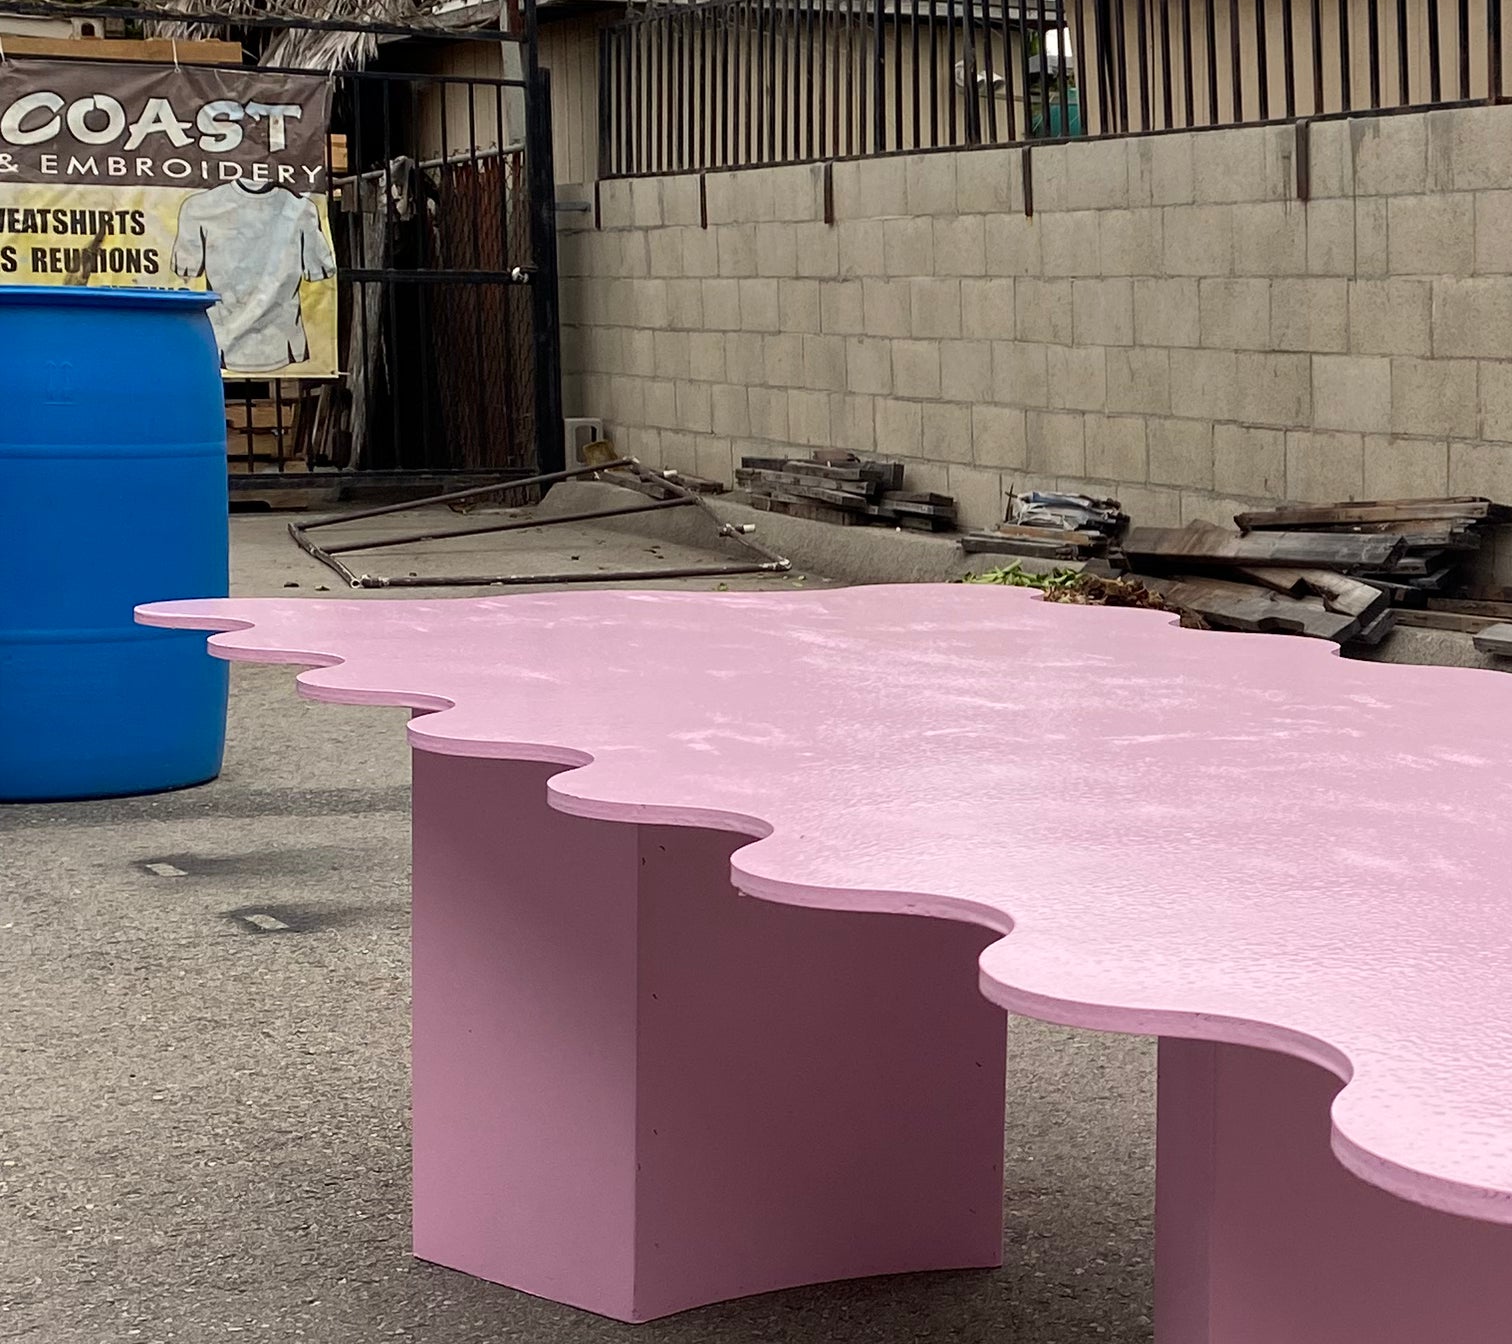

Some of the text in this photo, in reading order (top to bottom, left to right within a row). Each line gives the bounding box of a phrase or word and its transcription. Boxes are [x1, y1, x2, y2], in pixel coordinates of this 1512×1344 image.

[1, 91, 302, 153] COAST
[0, 153, 323, 184] & EMBROIDERY
[0, 208, 145, 236] EATSHIRTS
